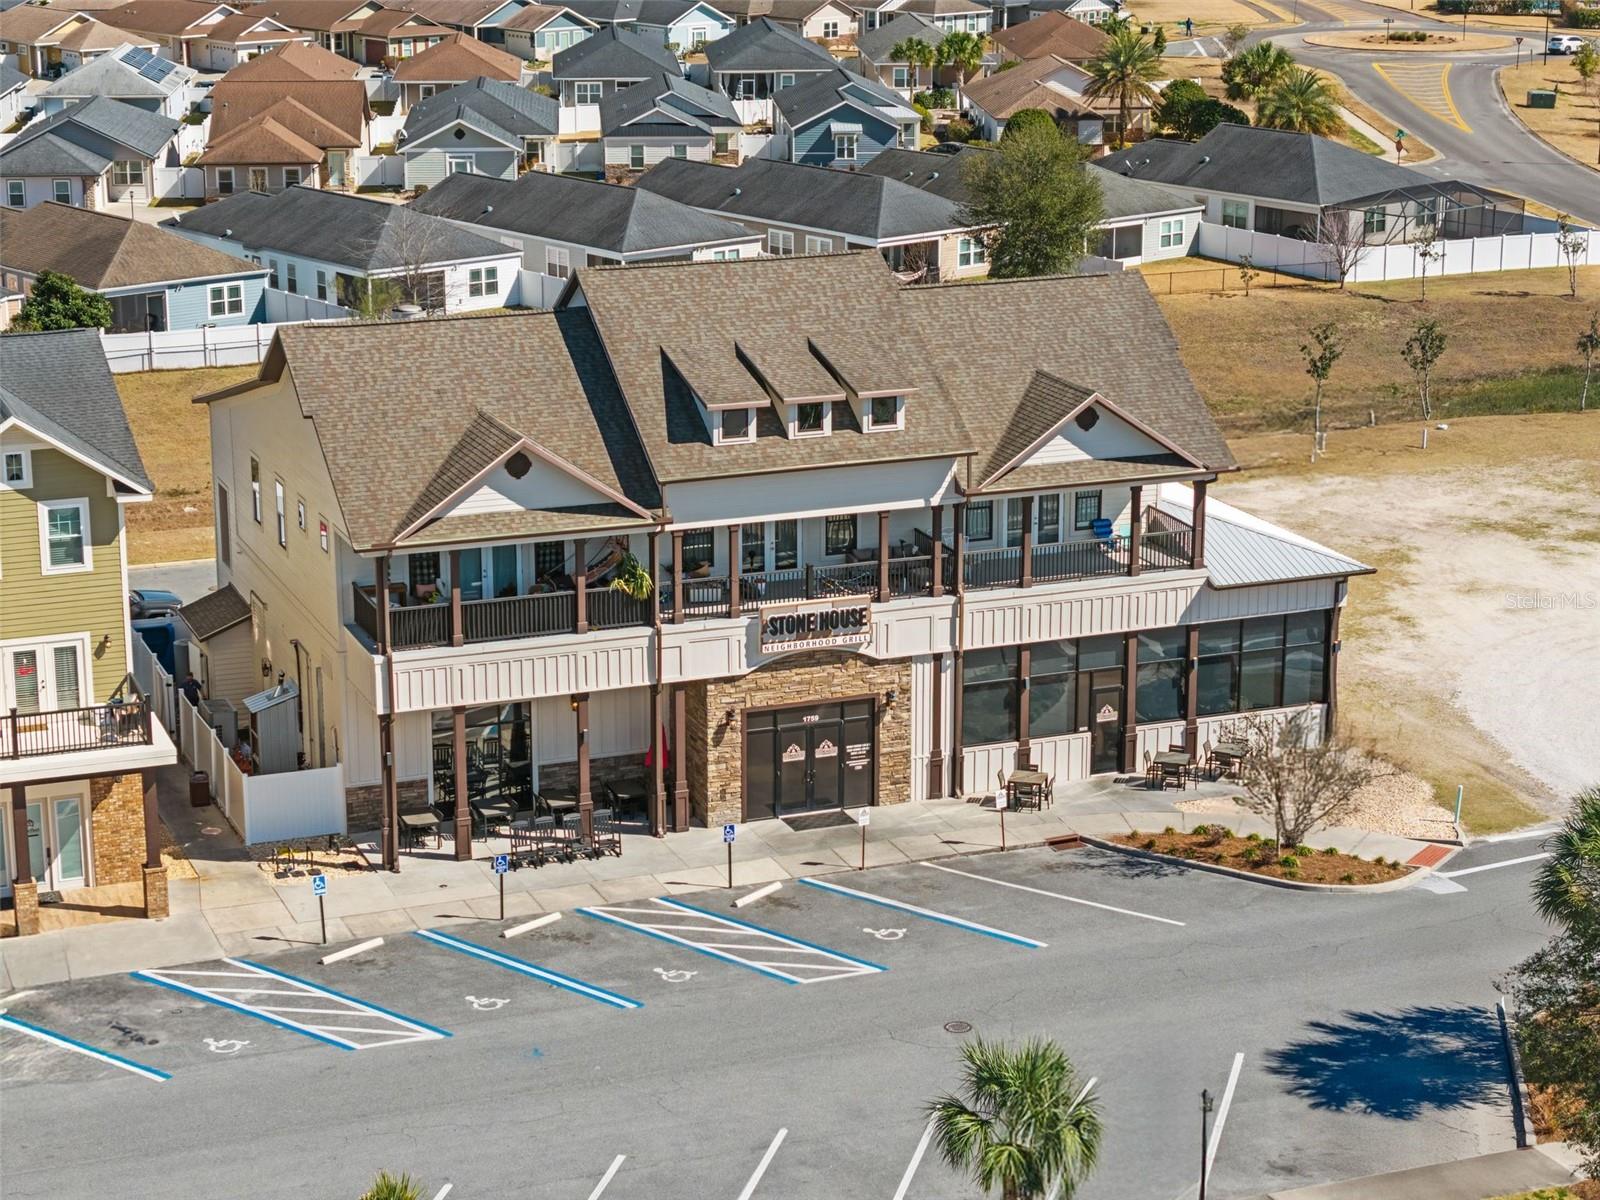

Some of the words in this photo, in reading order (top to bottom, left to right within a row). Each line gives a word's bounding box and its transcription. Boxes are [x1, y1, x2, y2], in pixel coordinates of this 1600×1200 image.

[768, 612, 816, 637] STONE
[819, 607, 868, 631] HOUSE
[764, 639, 837, 652] NEIGHBORHOOD
[842, 636, 868, 644] GRILL
[802, 715, 820, 723] 1759
